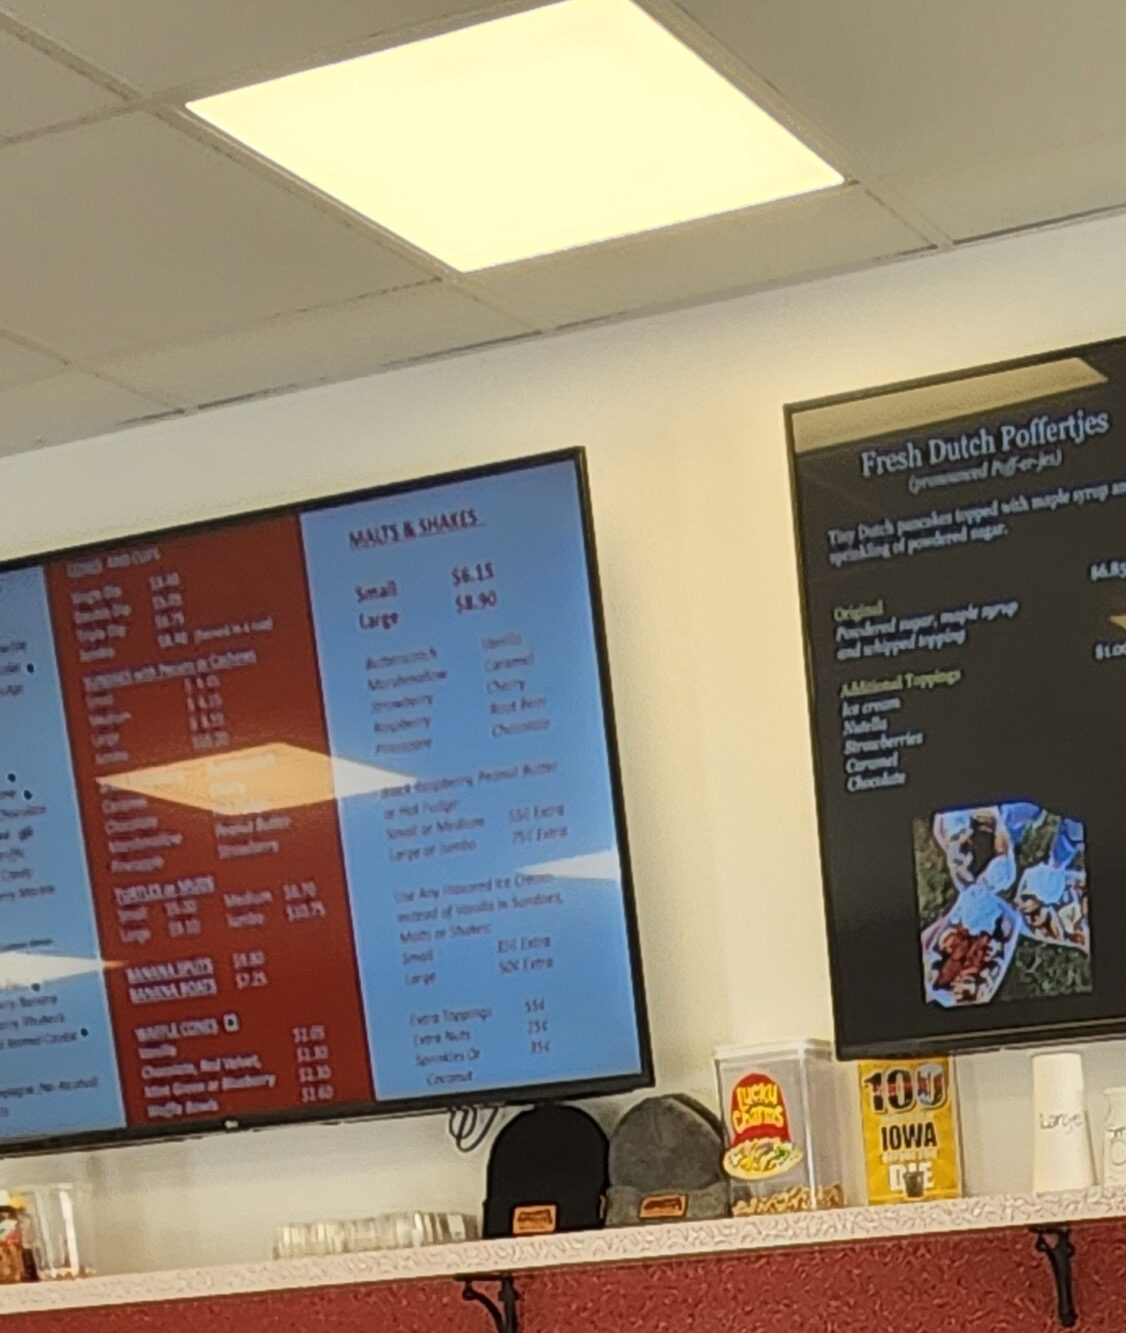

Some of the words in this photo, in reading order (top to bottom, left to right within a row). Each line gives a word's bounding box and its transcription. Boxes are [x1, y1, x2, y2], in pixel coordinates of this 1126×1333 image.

[860, 442, 923, 478] Fresh
[928, 428, 997, 466] Dutch
[1001, 409, 1111, 453] Poffertjes
[420, 507, 479, 533] SHAKES
[355, 580, 397, 603] Small
[737, 1083, 778, 1106] Lucky
[863, 1065, 947, 1113] 100
[733, 1105, 784, 1134] Charms
[1040, 1113, 1083, 1135] Large
[881, 1121, 938, 1153] IOWA
